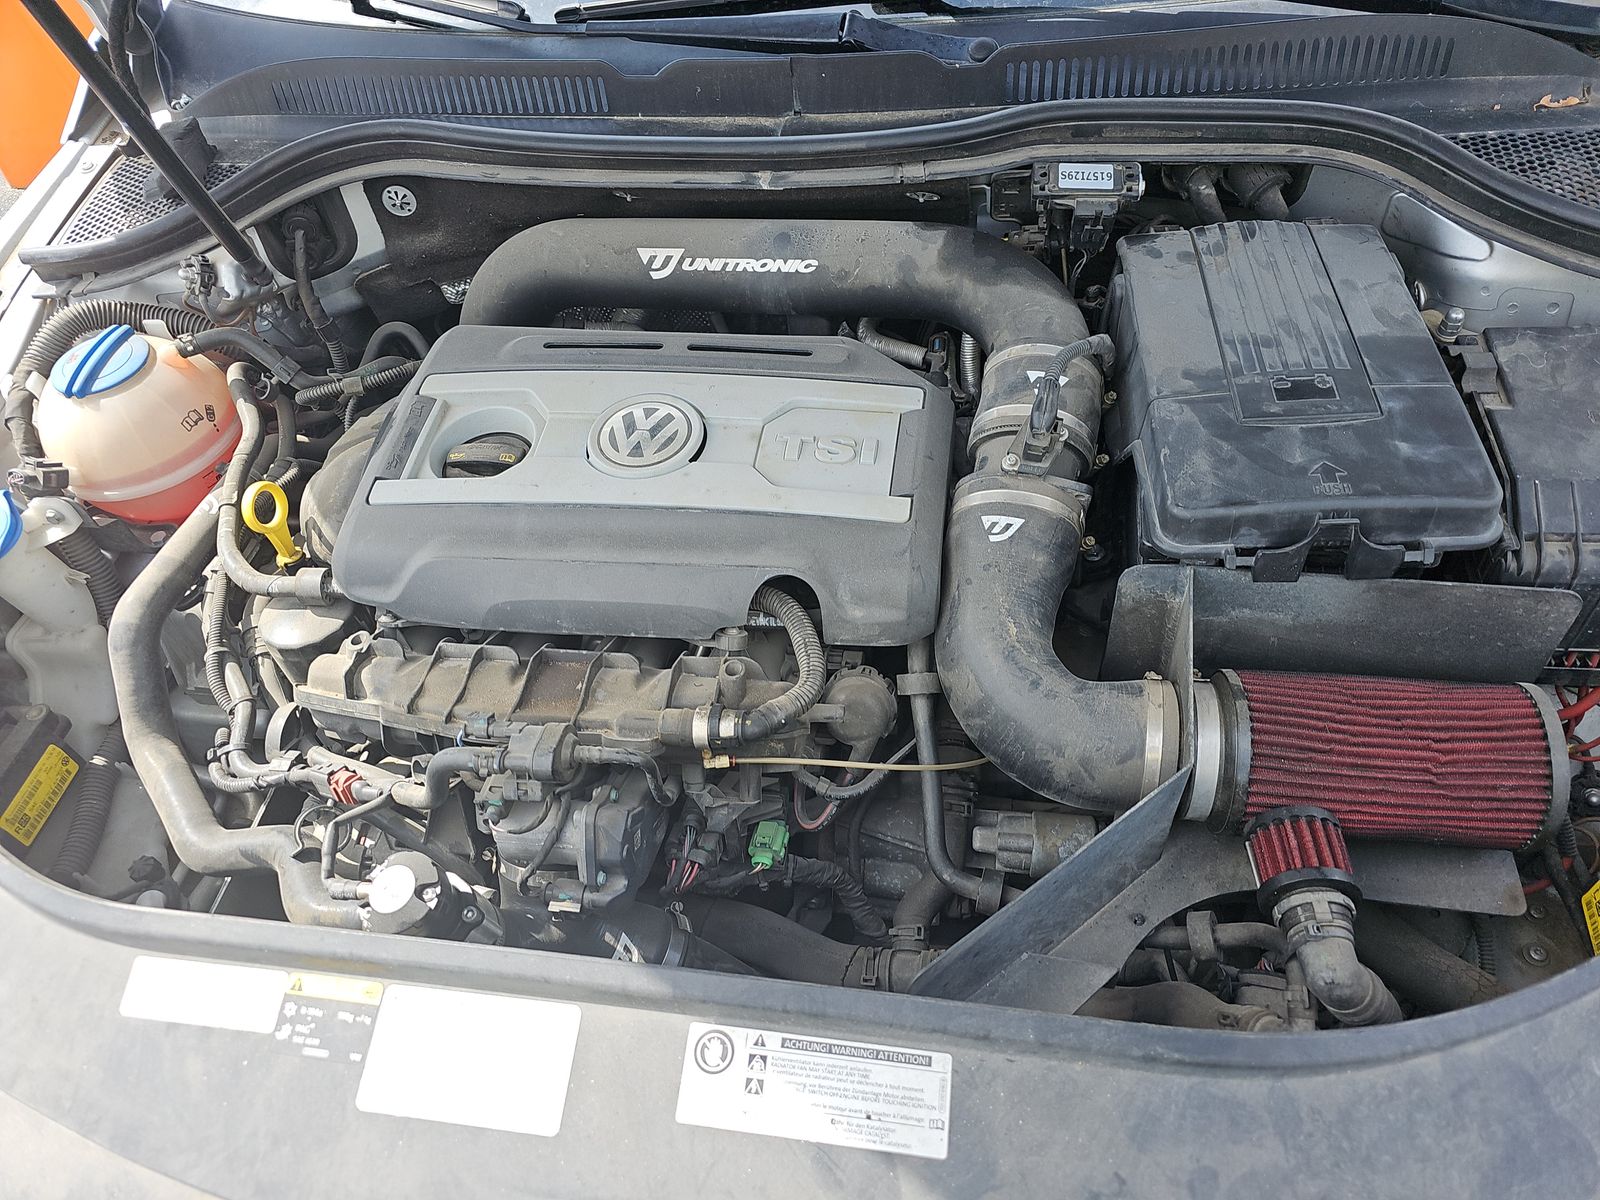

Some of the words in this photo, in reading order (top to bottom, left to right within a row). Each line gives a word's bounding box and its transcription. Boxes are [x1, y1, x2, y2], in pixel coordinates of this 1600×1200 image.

[681, 257, 819, 274] UNITRONIC
[774, 432, 880, 465] TSI
[784, 1039, 829, 1053] ACHTUNG!
[831, 1045, 878, 1059] WARNING!
[878, 1051, 929, 1065] ATTENTION!
